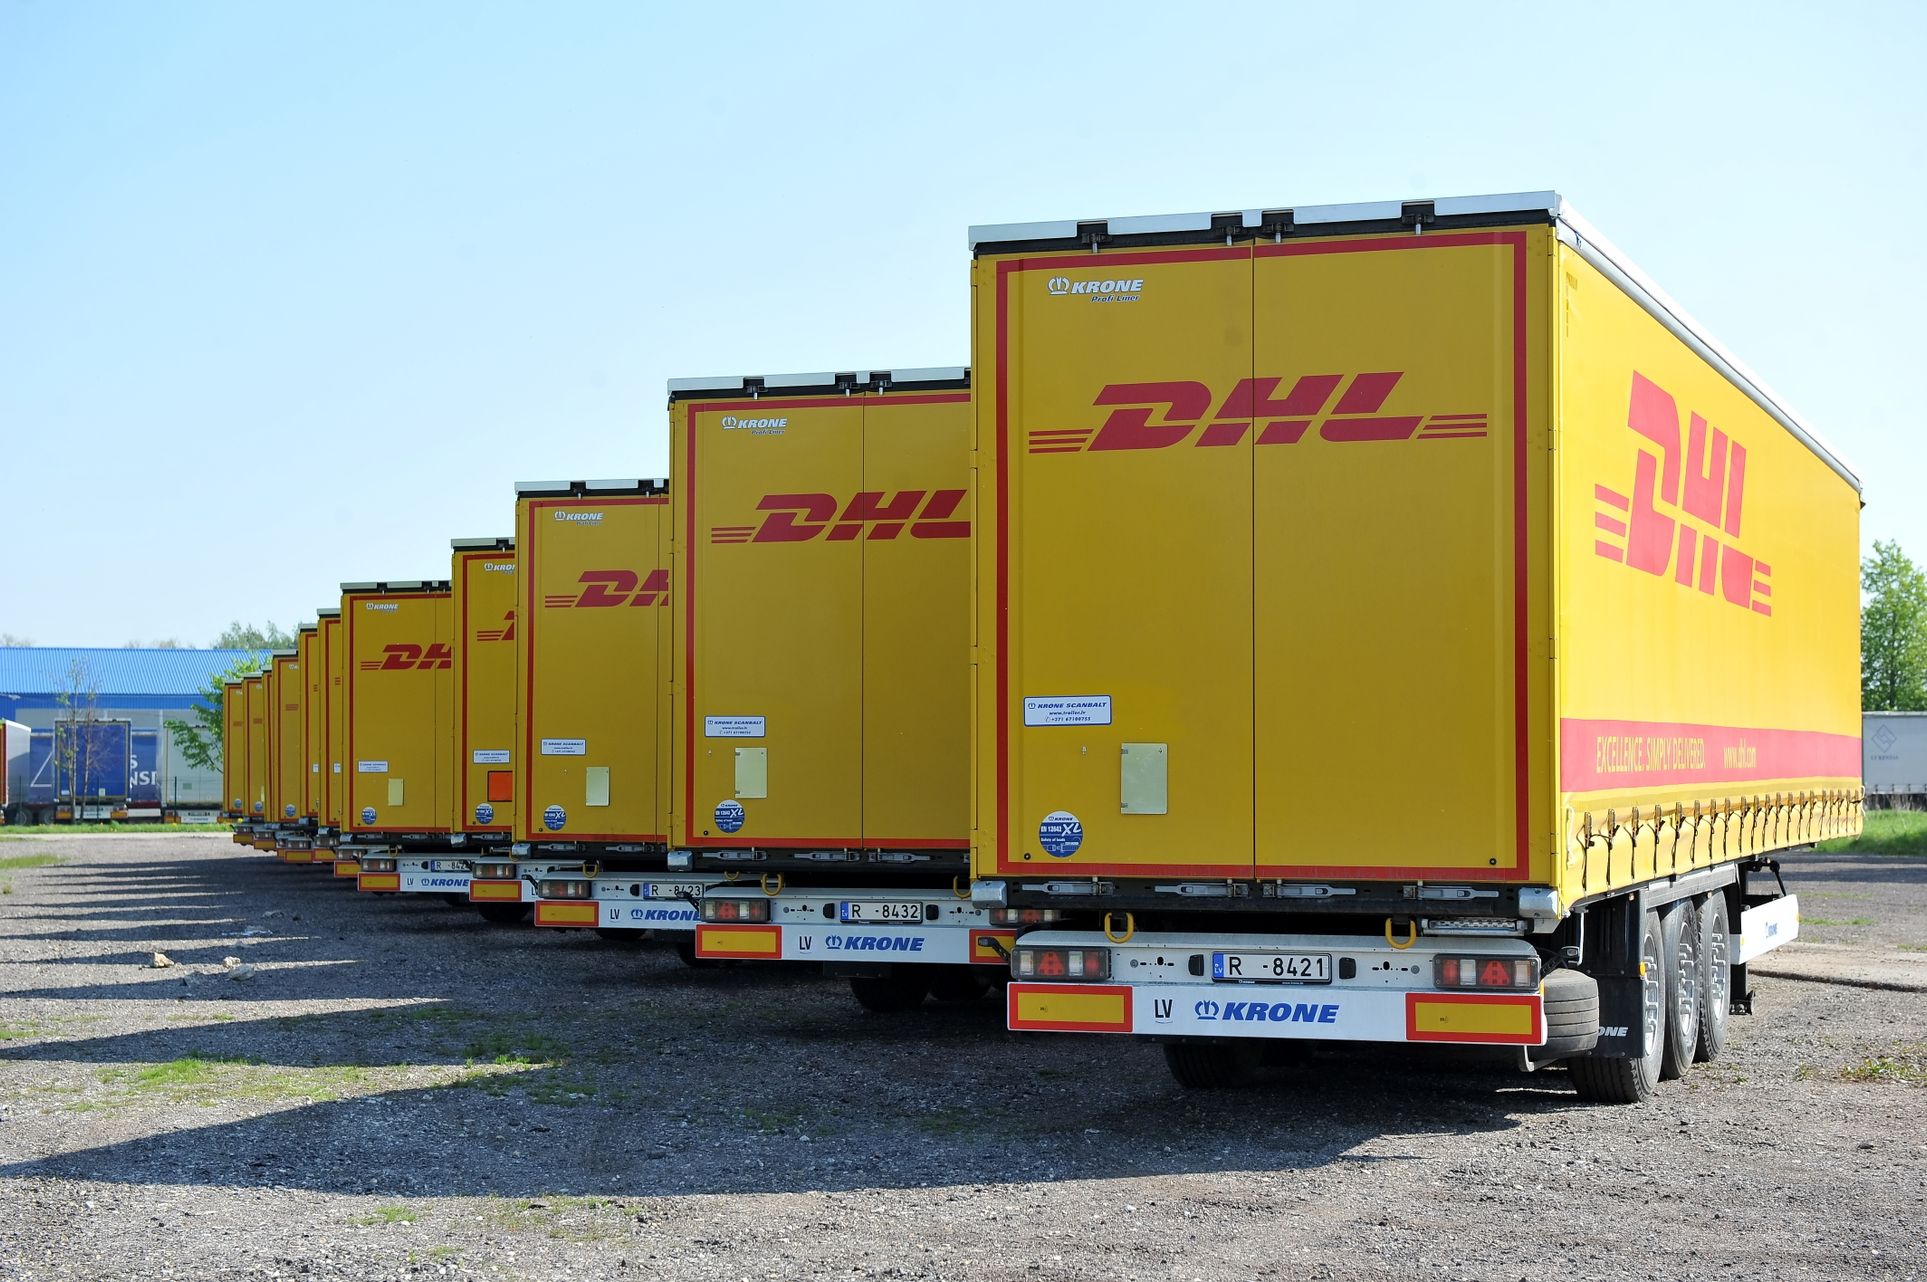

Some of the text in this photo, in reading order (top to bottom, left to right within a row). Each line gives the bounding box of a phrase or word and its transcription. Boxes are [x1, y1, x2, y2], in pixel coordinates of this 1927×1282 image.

[1071, 279, 1143, 294] KRONE
[1087, 371, 1423, 452] DHL
[738, 418, 788, 429] KRONE
[1626, 369, 1754, 609] DHL
[566, 512, 604, 521] KRONE
[752, 489, 971, 543] DHL
[1061, 822, 1082, 837] XL
[430, 878, 470, 887] KRONE
[651, 884, 659, 896] R
[610, 908, 620, 920] LV
[852, 904, 861, 918] R
[799, 936, 925, 952] LV KRONE
[1229, 956, 1242, 976] R
[1154, 999, 1340, 1023] LV KRONE
